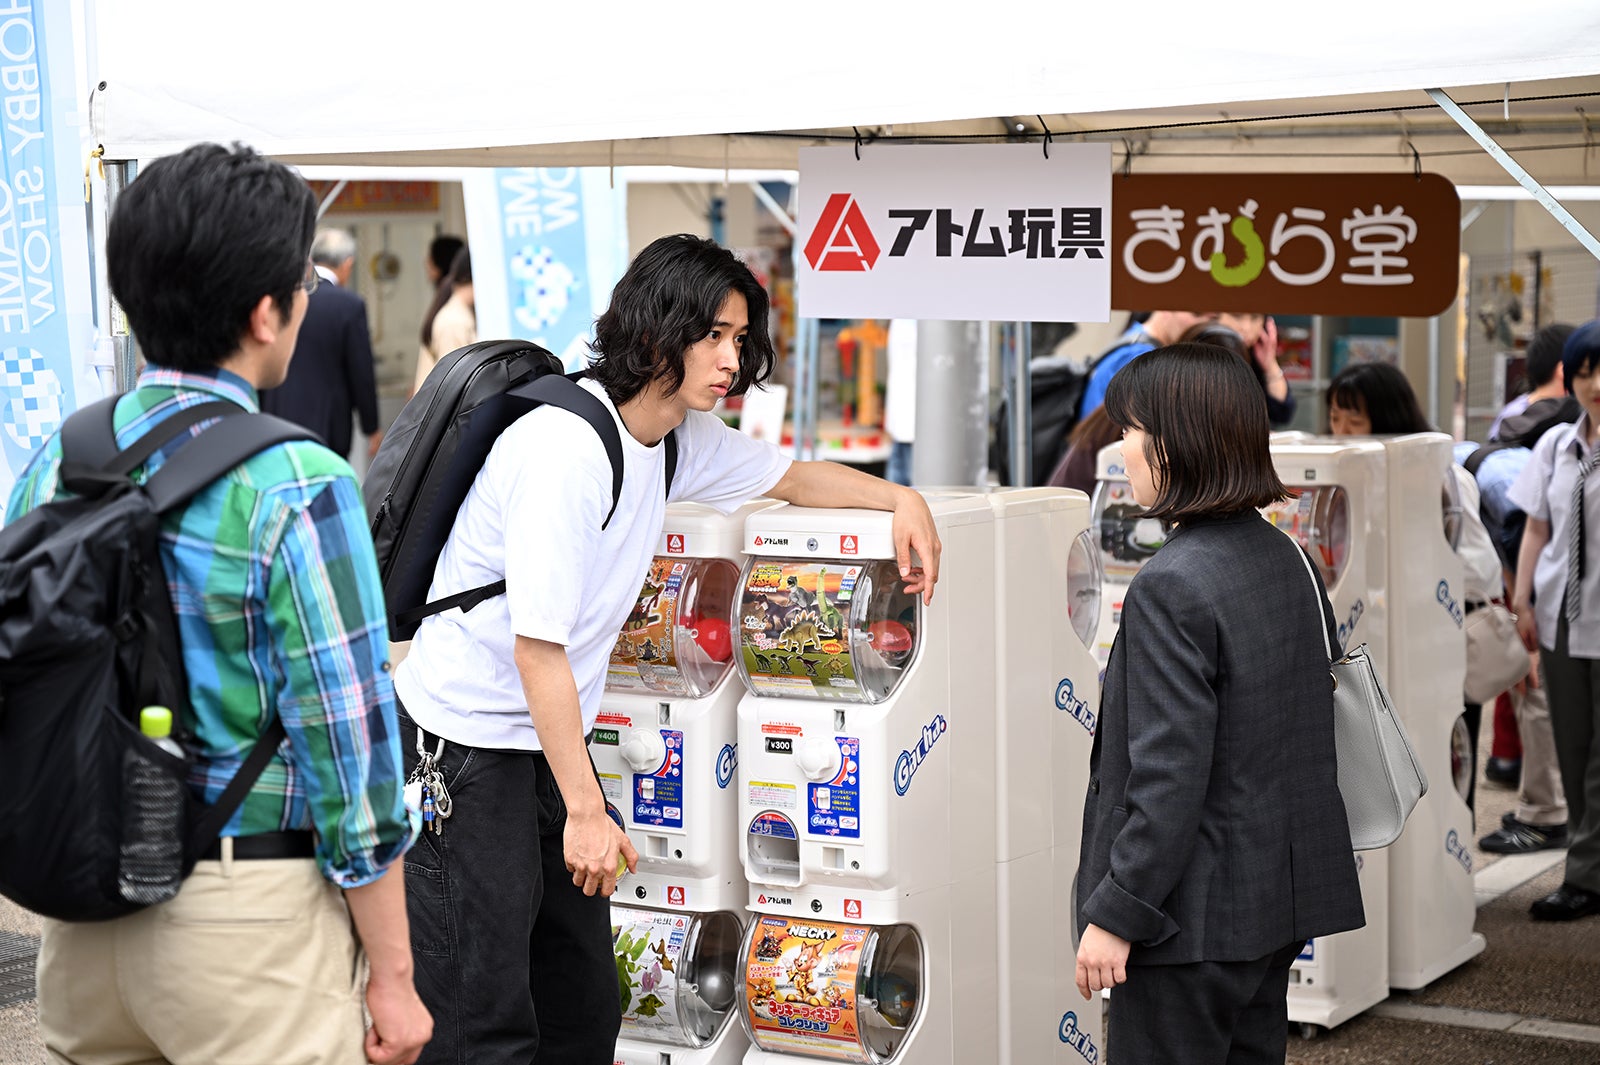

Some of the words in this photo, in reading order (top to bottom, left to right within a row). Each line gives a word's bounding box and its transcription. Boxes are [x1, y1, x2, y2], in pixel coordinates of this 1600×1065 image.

[888, 207, 1105, 259] アトム玩具
[1122, 203, 1418, 287] きむら堂
[598, 733, 617, 741] ¥400
[770, 741, 790, 750] ¥300
[788, 926, 836, 940] NECKY
[768, 999, 841, 1024] ネッキーフィギュア
[778, 1016, 830, 1032] コレクション
